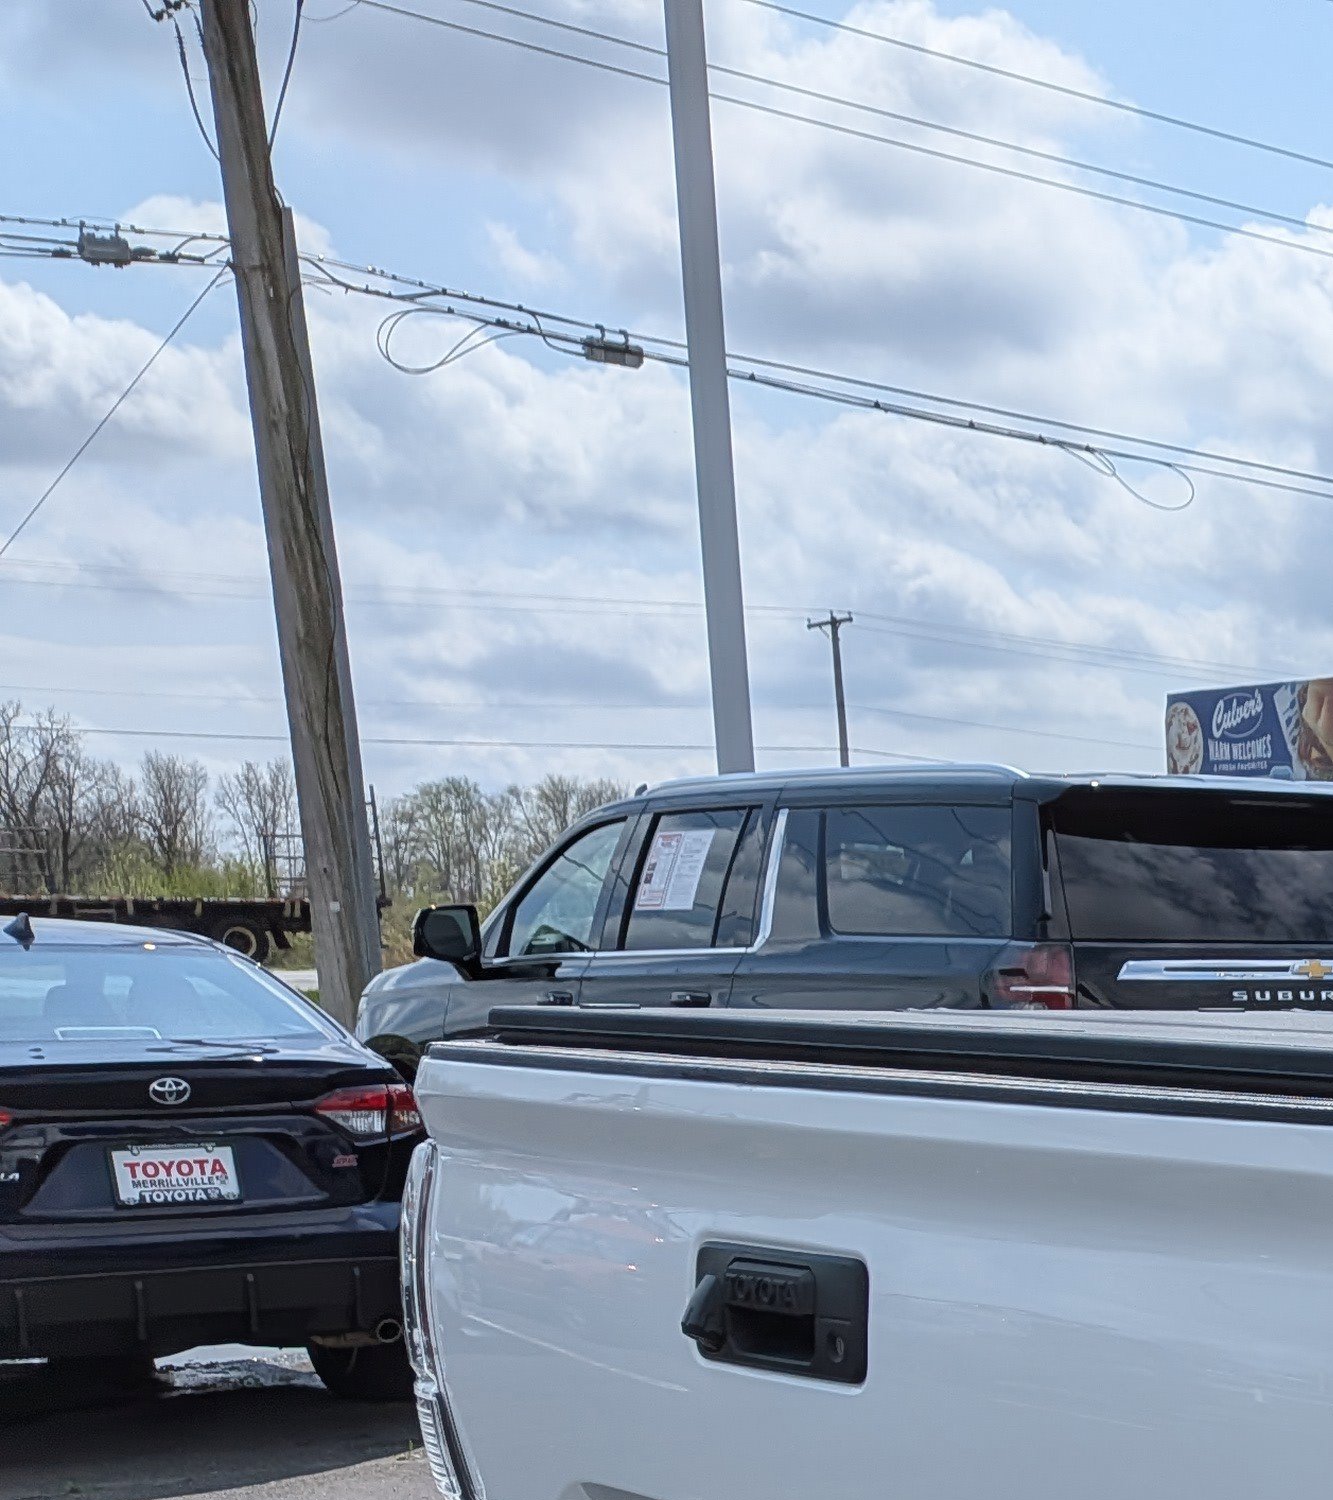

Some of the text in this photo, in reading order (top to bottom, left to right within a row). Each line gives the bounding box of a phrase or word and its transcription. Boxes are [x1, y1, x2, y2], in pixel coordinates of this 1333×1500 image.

[1211, 688, 1264, 739] Culver's
[1207, 733, 1272, 762] WARM WELCOMES
[123, 1158, 228, 1179] TOYOTA
[131, 1176, 215, 1189] MERRILLVILLE
[140, 1188, 209, 1203] TOYOTA
[724, 1272, 800, 1310] TOYOTA
